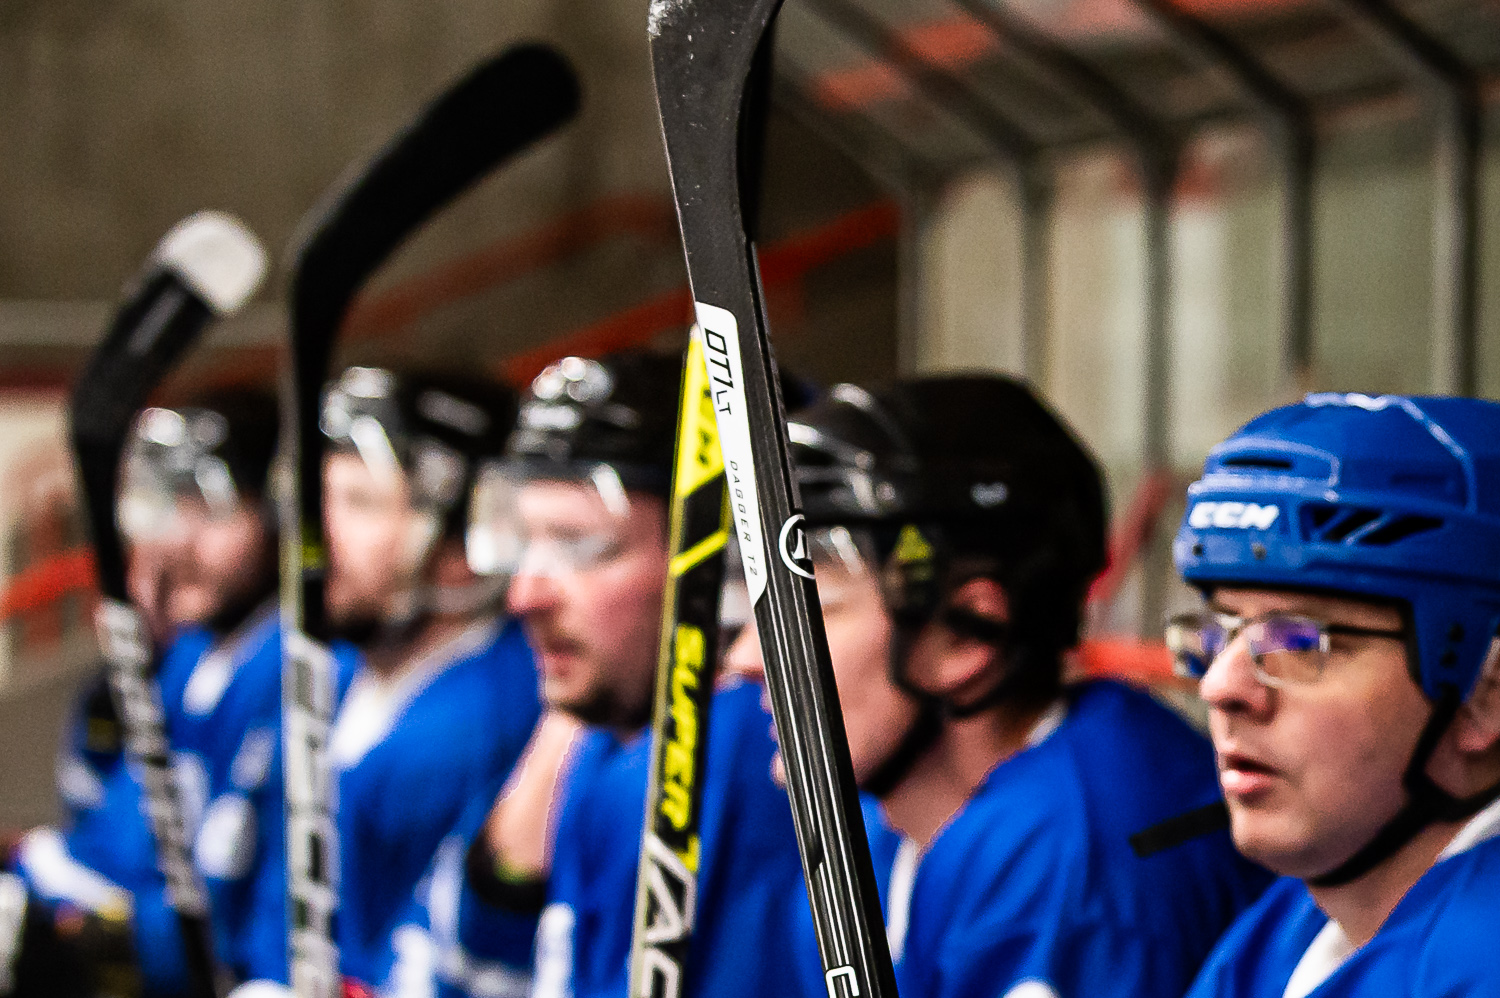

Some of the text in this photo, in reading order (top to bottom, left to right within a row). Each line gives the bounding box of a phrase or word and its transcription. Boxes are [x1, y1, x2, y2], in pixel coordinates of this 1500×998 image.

[729, 459, 758, 577] DAGGER T2
[1188, 501, 1279, 530] CCM
[661, 622, 706, 829] SUPER
